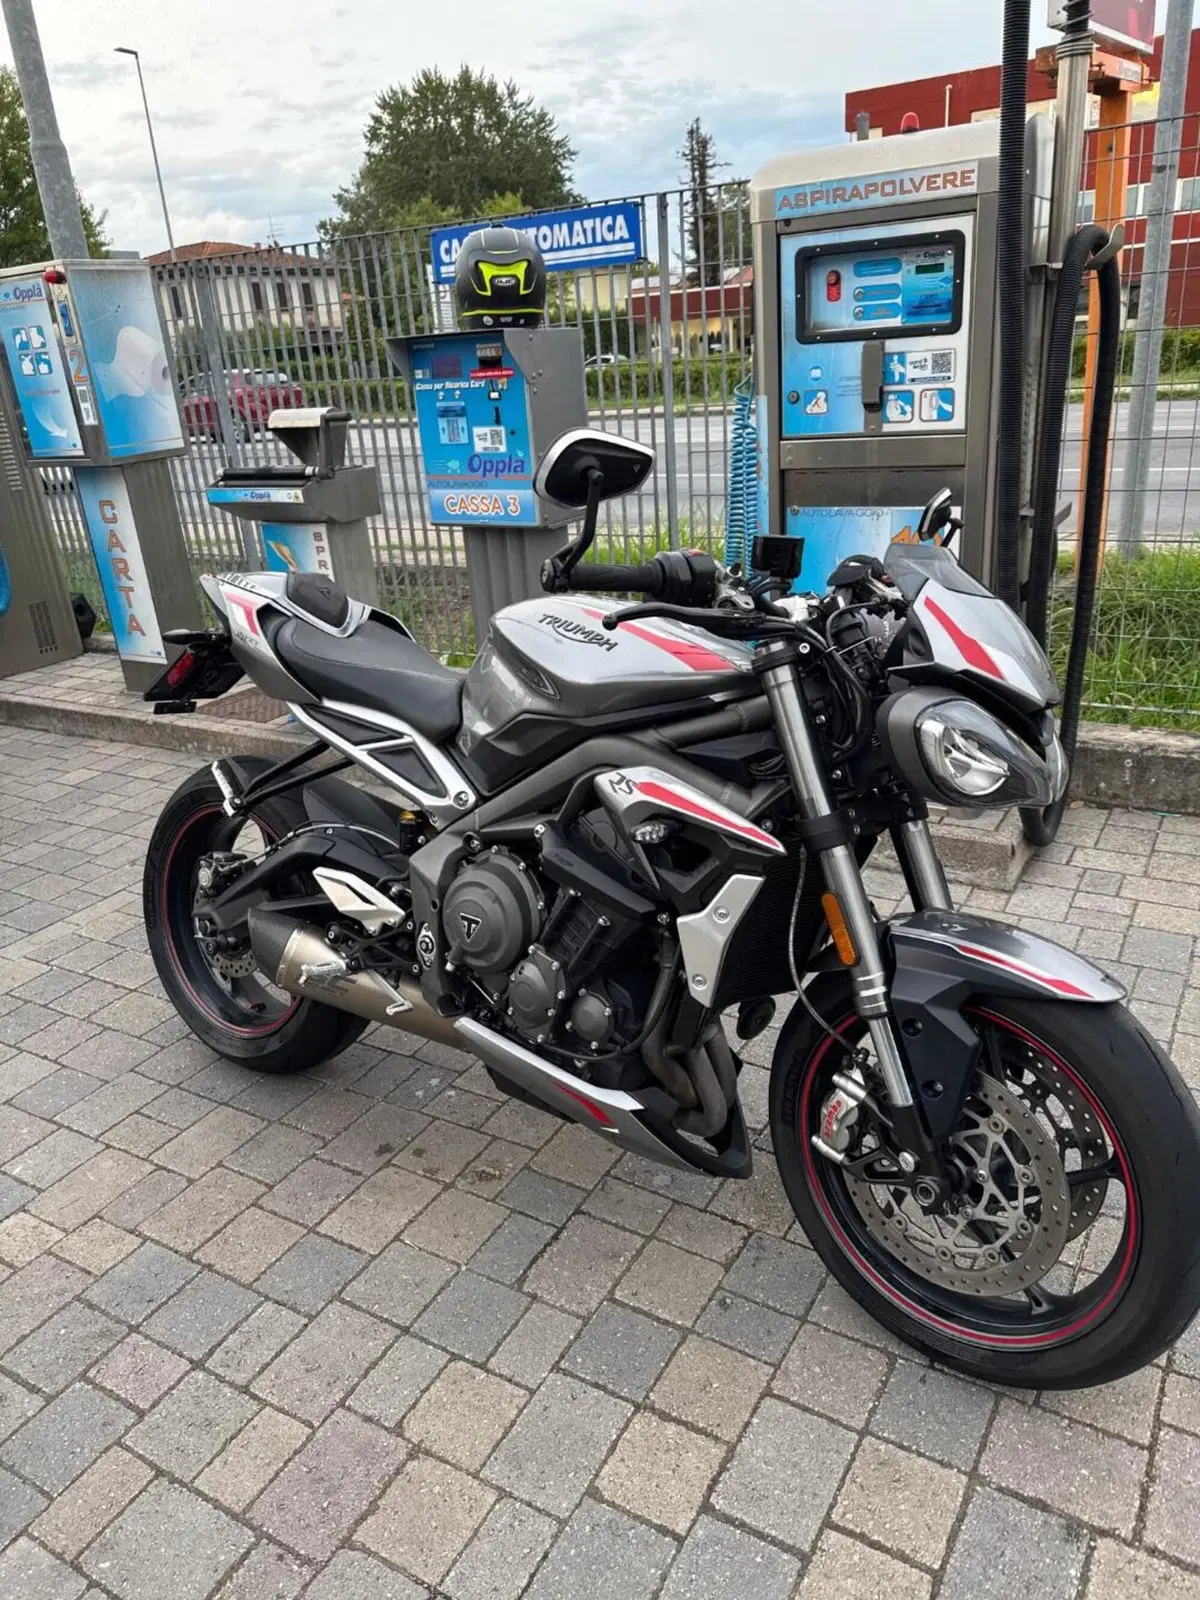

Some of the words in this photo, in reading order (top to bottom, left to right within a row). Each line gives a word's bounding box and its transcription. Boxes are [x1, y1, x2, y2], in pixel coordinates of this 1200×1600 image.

[777, 168, 976, 212] ASPIRAPOLVERE
[521, 214, 630, 251] TOMATICA
[13, 283, 43, 302] Opplà
[69, 349, 89, 382] 2
[444, 494, 504, 515] CASSA
[507, 494, 520, 515] 3
[99, 499, 146, 637] CARTA
[313, 531, 329, 571] SPR
[538, 613, 618, 652] TRIUMPH
[824, 1100, 842, 1138] brembo
